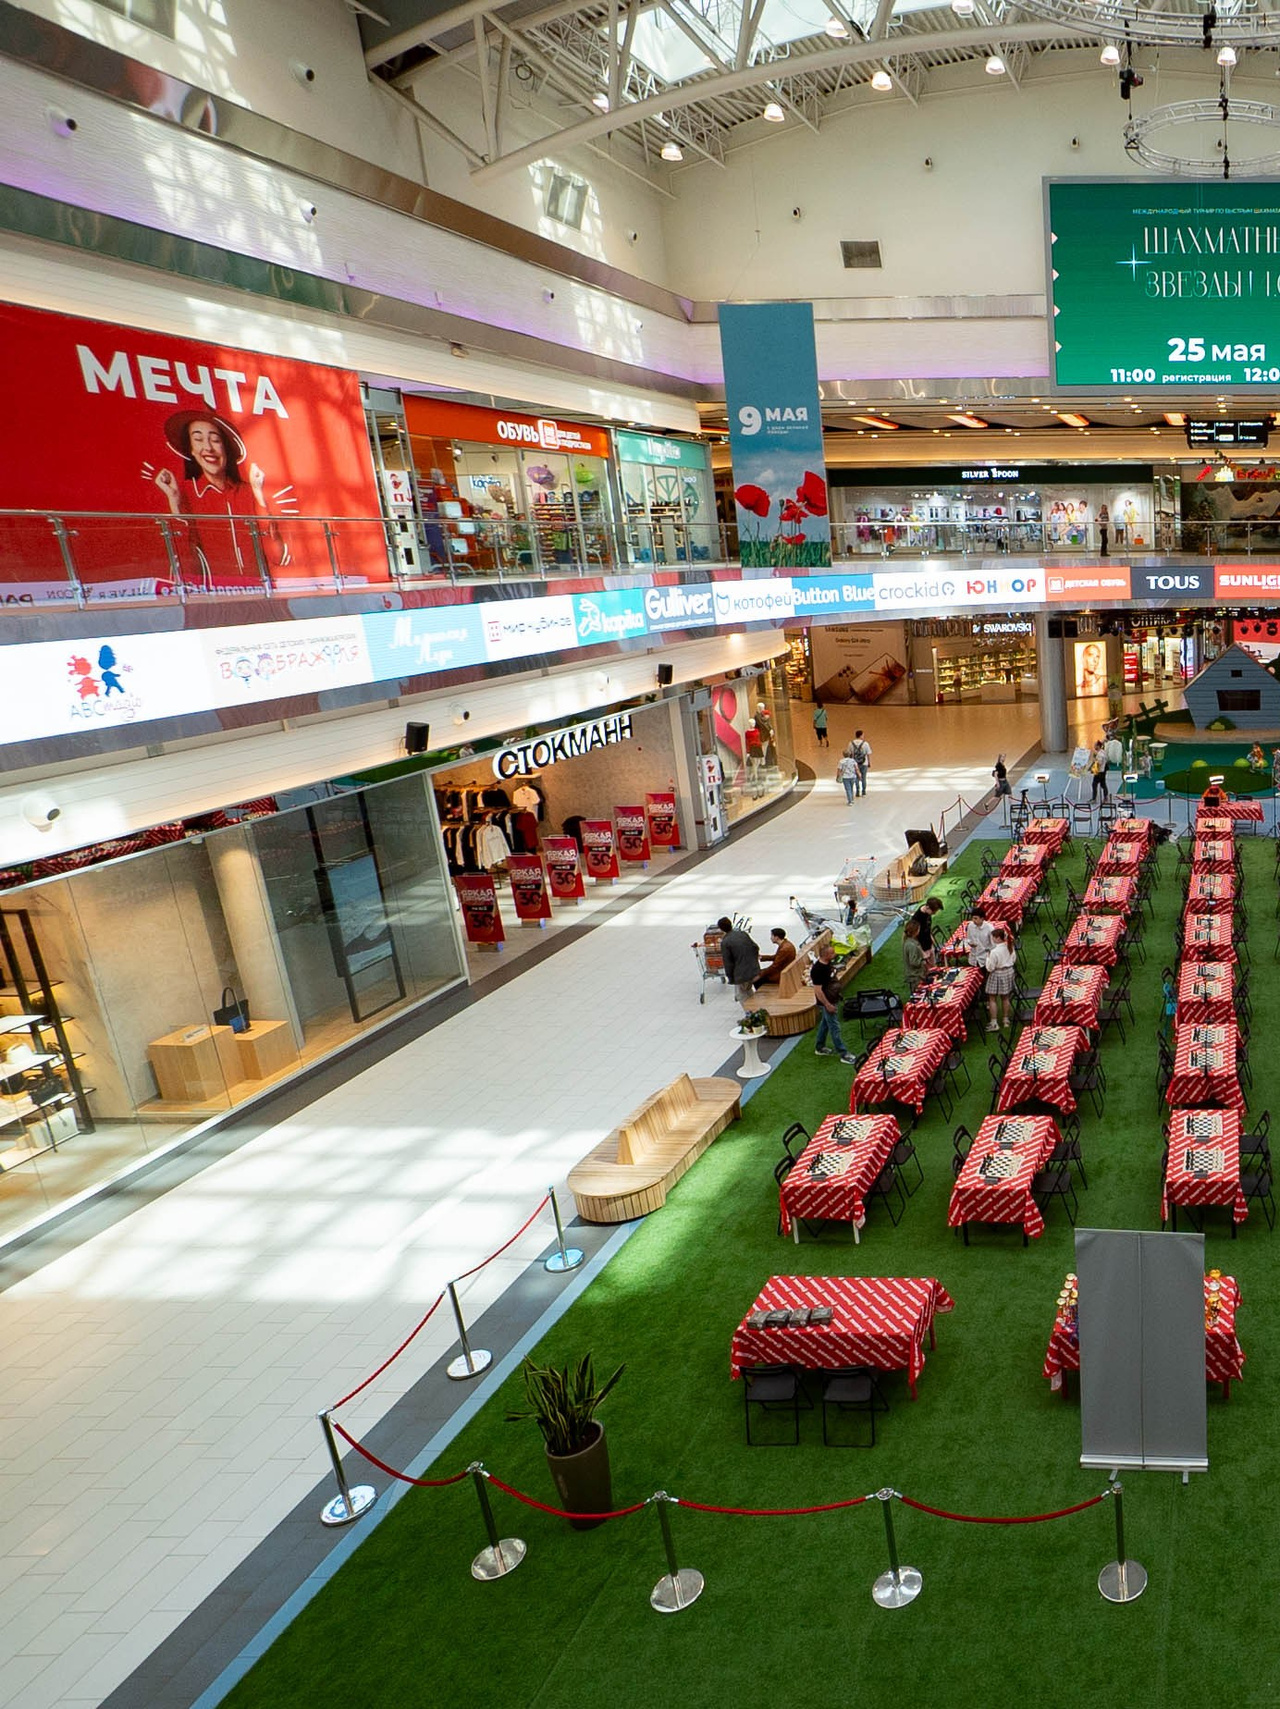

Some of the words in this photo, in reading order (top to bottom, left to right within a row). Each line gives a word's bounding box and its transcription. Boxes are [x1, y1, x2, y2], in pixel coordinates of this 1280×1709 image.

[1145, 270, 1242, 299] ЗВЕЗДЫ
[1167, 338, 1205, 362] 25
[1212, 343, 1266, 362] мая
[76, 344, 289, 419] МЕЧТА
[1110, 369, 1156, 383] 11:00
[1162, 373, 1232, 384] регистрация
[739, 406, 762, 436] 9
[765, 407, 809, 422] МАЯ
[497, 420, 540, 443] ОБУВЬ
[879, 581, 939, 600] crockid
[967, 578, 1037, 595] ЮНОР
[1146, 575, 1200, 589] TOUS
[734, 593, 792, 611] котофей
[792, 586, 840, 605] Button
[842, 584, 875, 603] Blue
[983, 622, 1032, 634] SWAROVSKI
[1131, 613, 1173, 628] ОПТИК
[492, 714, 633, 780] СТОКМАНН
